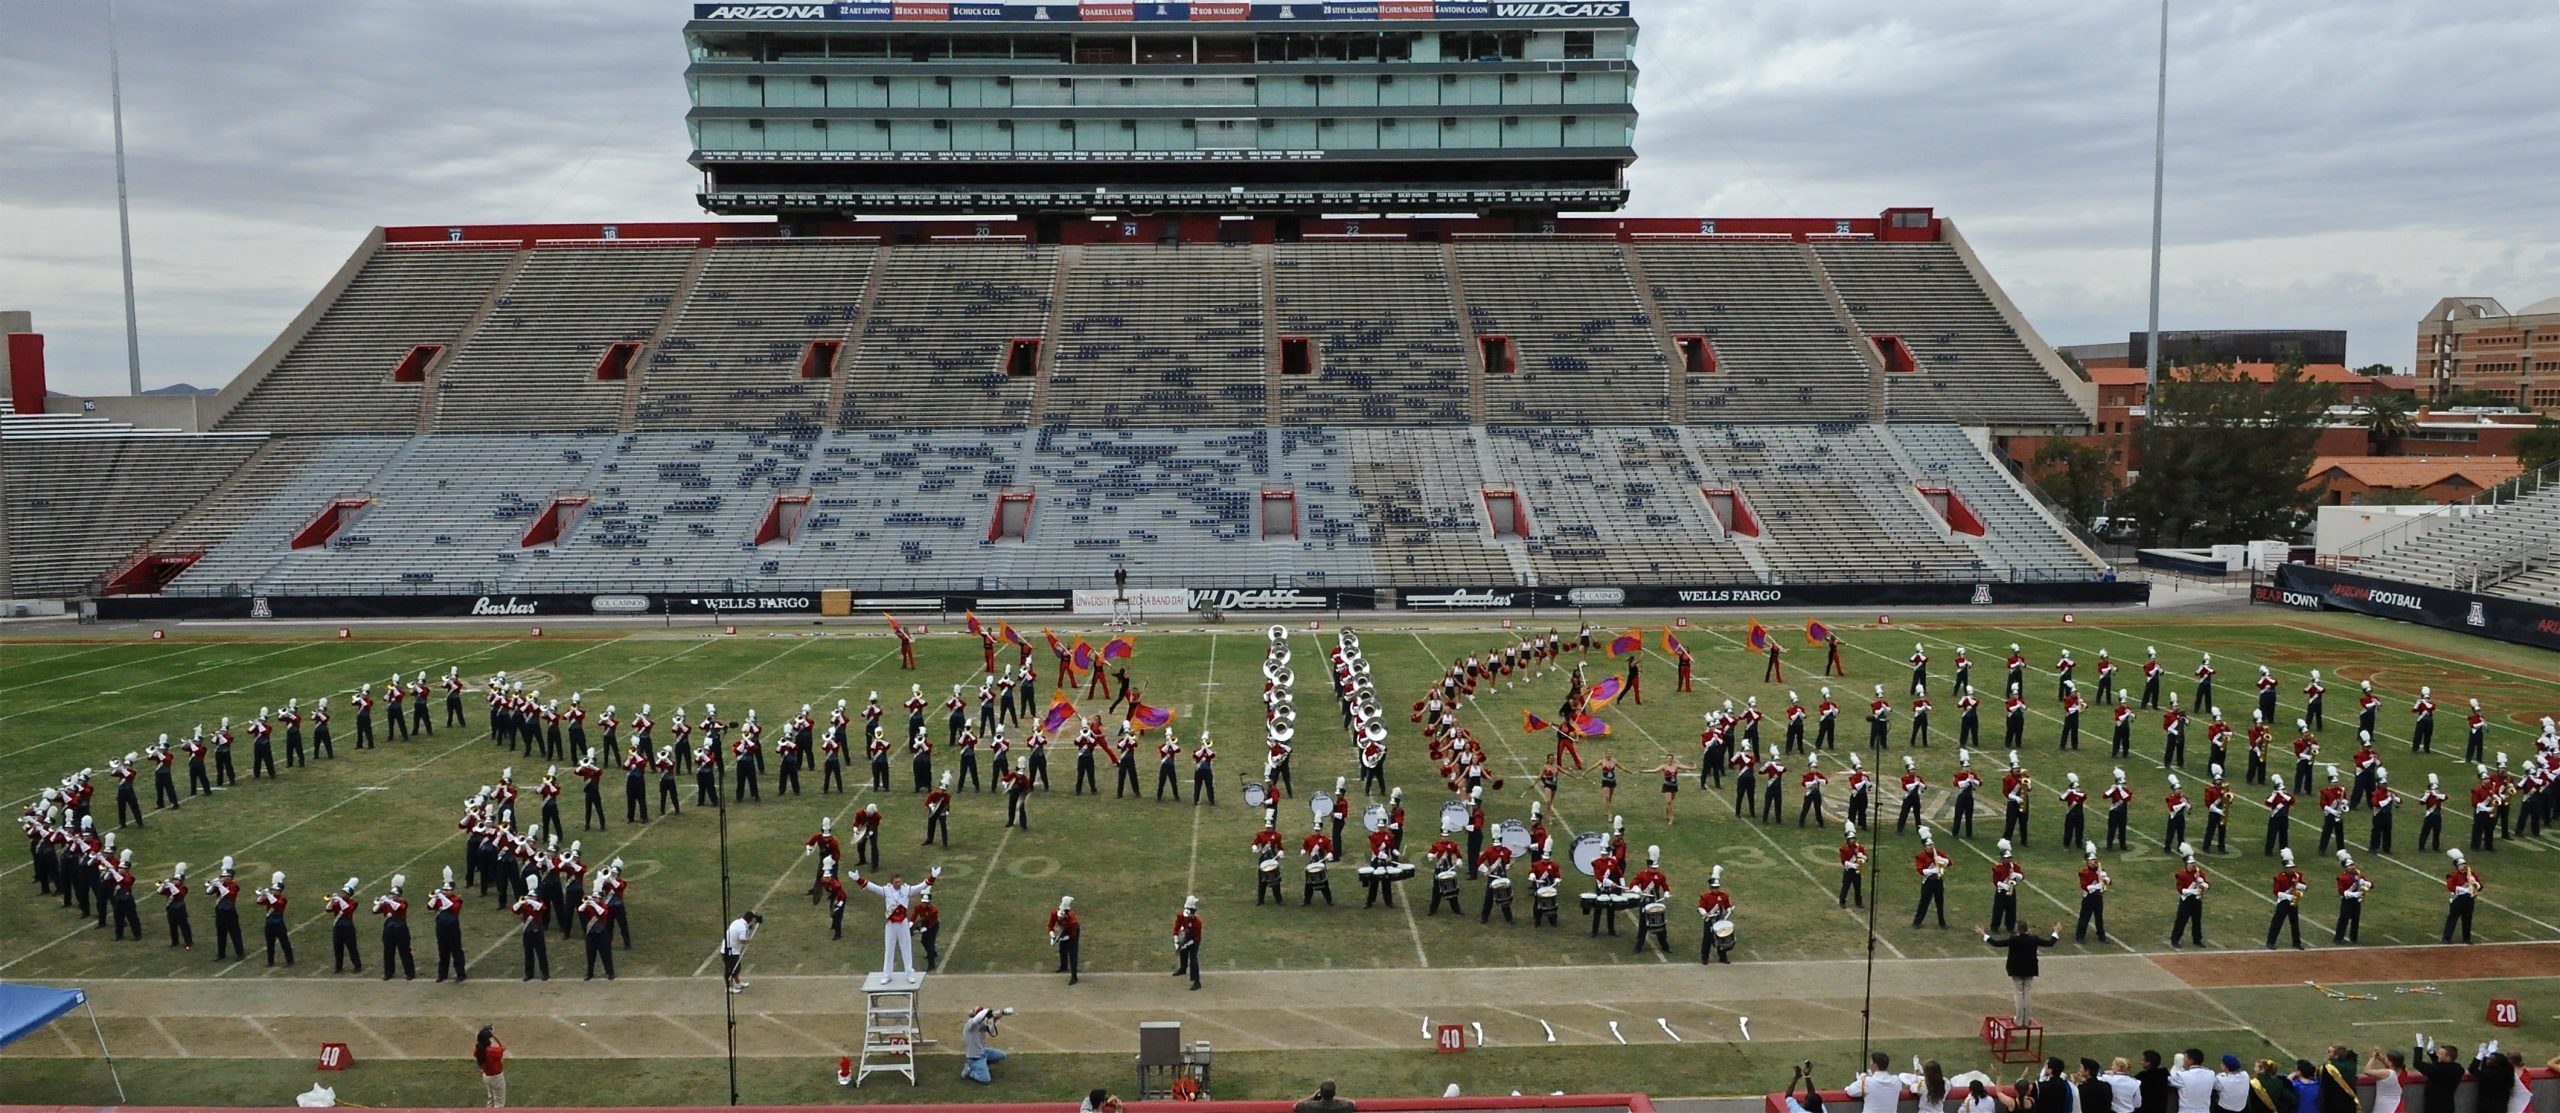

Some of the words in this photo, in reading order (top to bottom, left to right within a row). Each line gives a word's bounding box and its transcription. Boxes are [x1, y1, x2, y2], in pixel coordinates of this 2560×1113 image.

[707, 6, 824, 19] ARIZONA
[1496, 4, 1622, 16] WILDCATS
[780, 229, 791, 238] 19
[976, 227, 989, 236] 20
[1125, 227, 1136, 235] 21
[1347, 226, 1359, 234] 22
[1542, 225, 1555, 233] 23
[1702, 226, 1714, 234] 24
[1837, 225, 1849, 234] 25
[451, 232, 460, 241] 17
[604, 231, 616, 239] 18
[85, 401, 95, 410] 16
[1679, 591, 1732, 601] WELLS
[1732, 590, 1781, 601] FARGO
[2368, 589, 2422, 610] FOOTBALL
[472, 596, 537, 615] Bashas'
[704, 599, 755, 609] WELLS
[759, 598, 809, 608] FARGO
[1076, 597, 1109, 606] UNIVERSITY
[1152, 596, 1170, 605] BAND
[1172, 596, 1184, 605] DAY
[2496, 1004, 2516, 1023] 20
[1442, 1029, 1460, 1048] 40
[321, 1046, 340, 1066] 40
